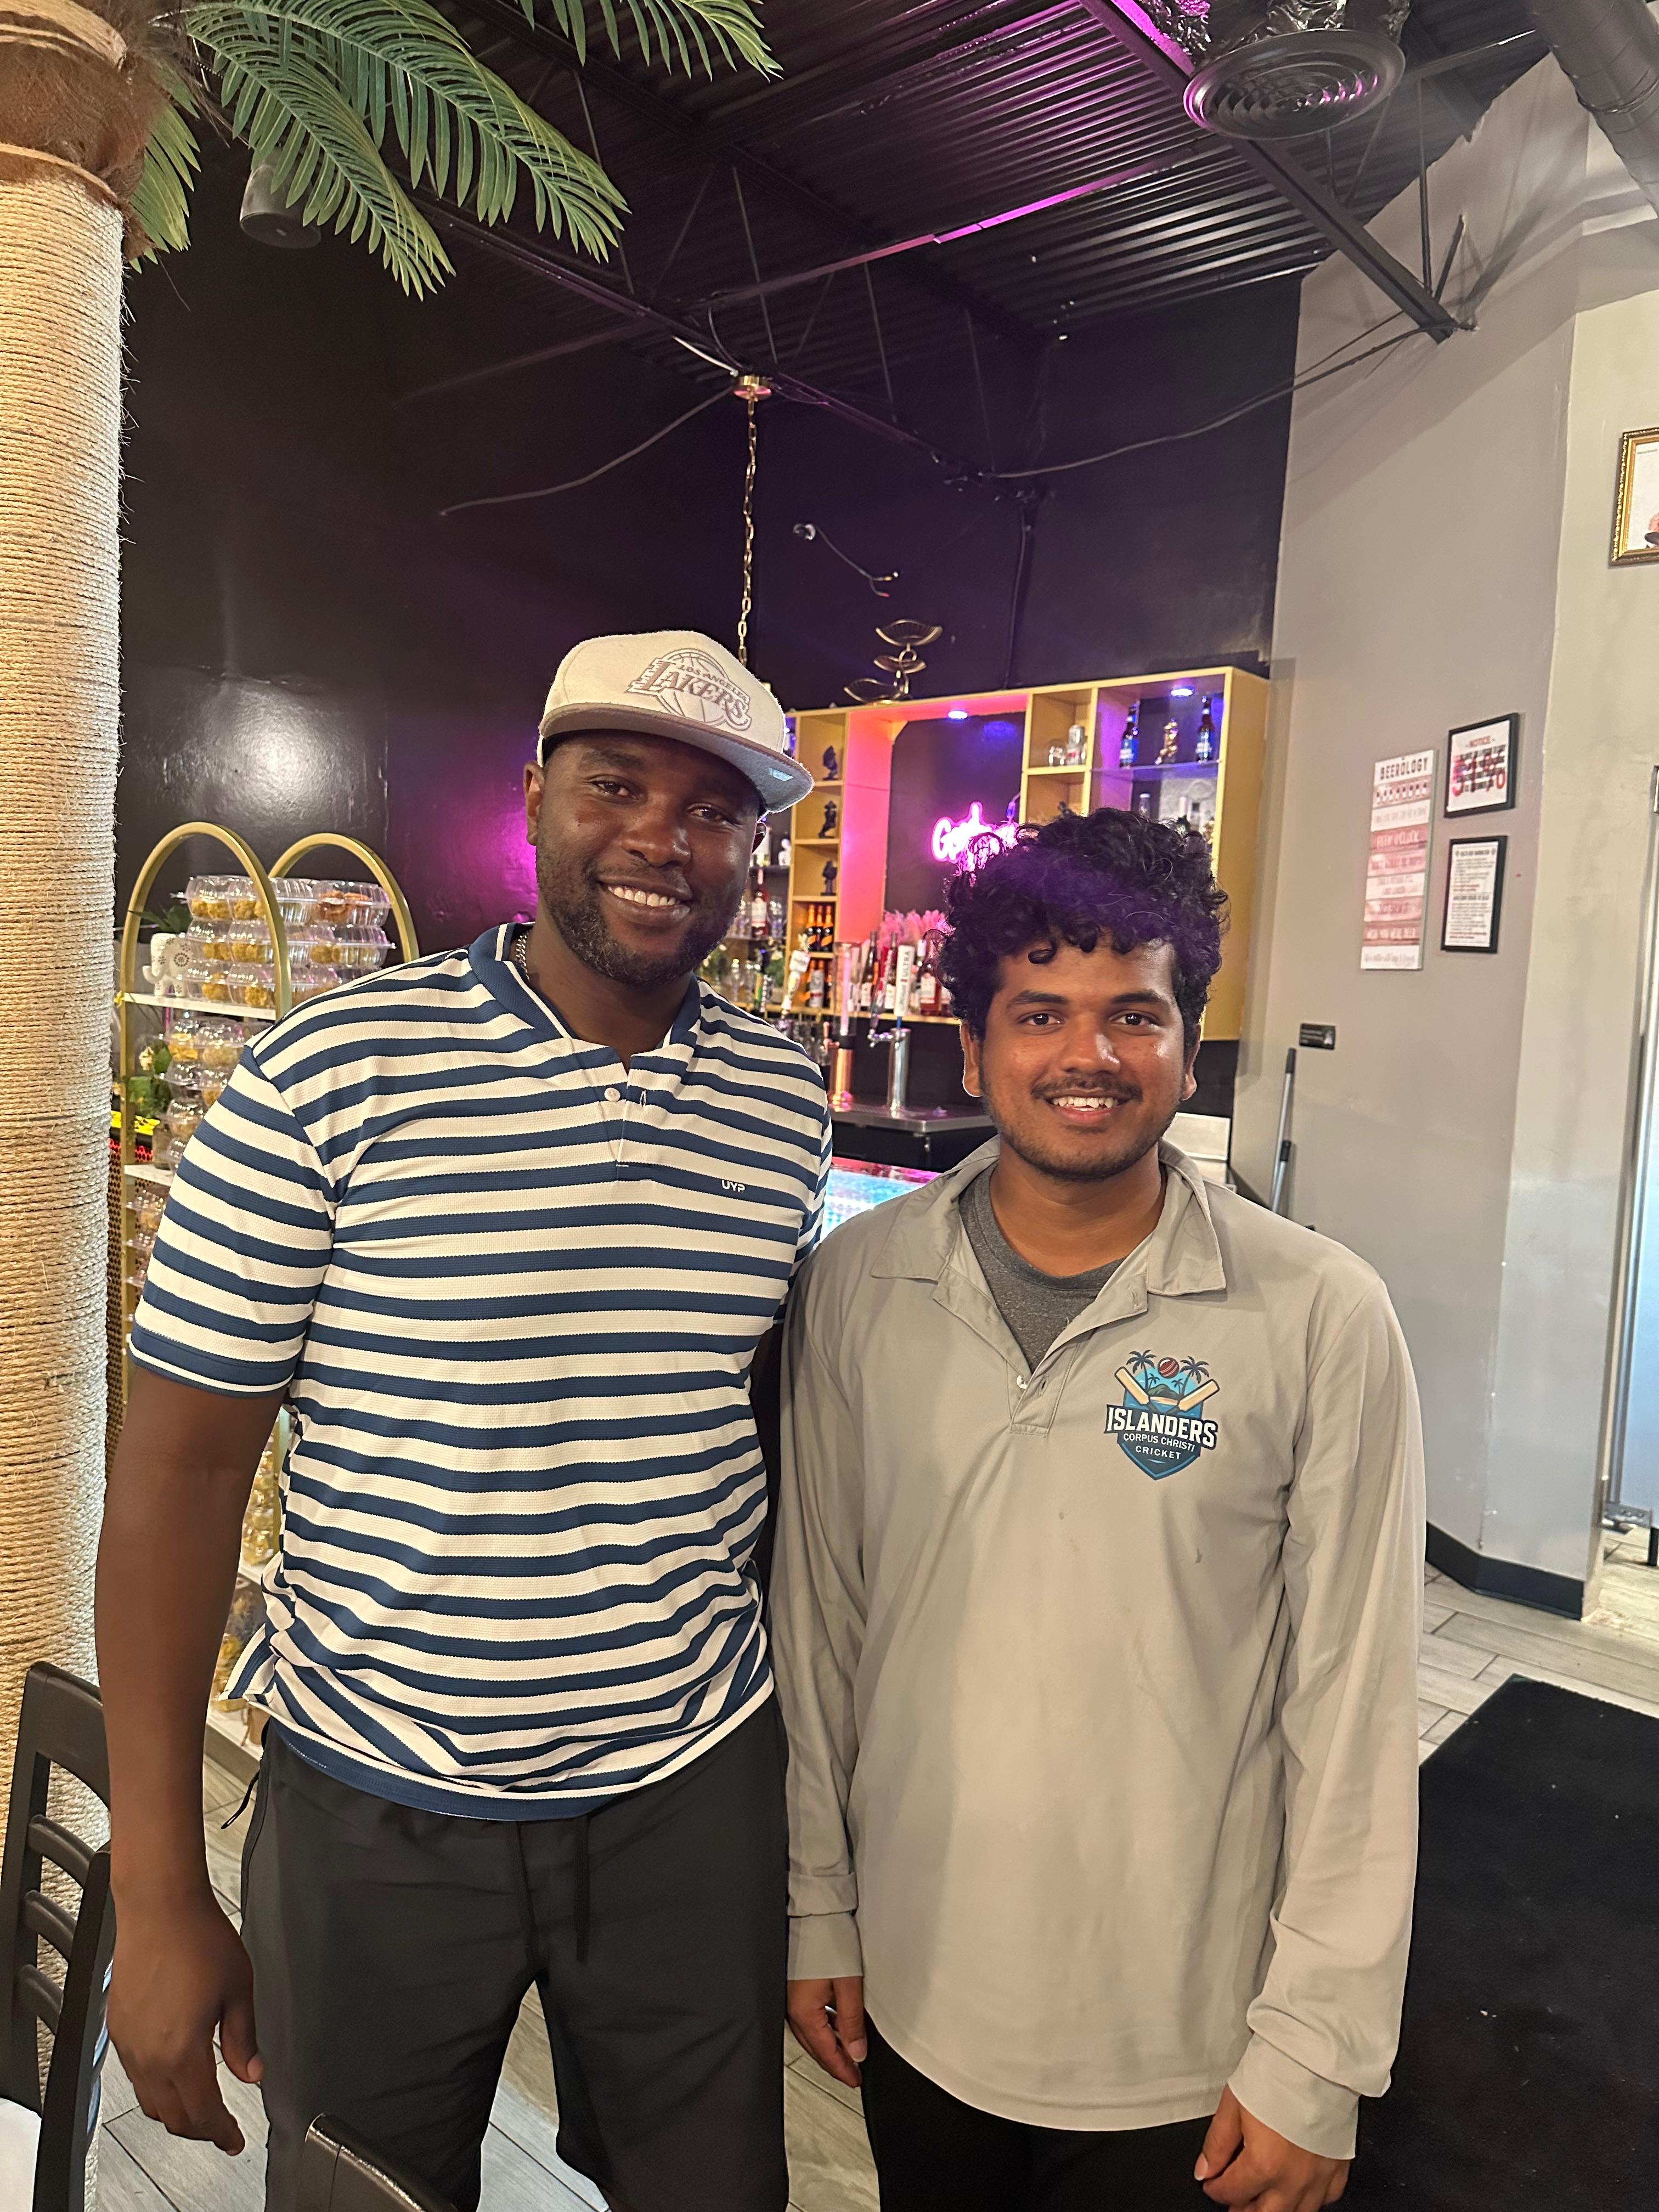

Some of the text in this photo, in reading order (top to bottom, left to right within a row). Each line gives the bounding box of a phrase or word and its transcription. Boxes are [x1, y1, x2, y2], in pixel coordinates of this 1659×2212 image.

[635, 660, 749, 726] LAKERS
[677, 664, 748, 702] LOS ANGELES
[1380, 757, 1429, 780] BEEROLOGY
[721, 1180, 746, 1192] UYP
[1106, 1407, 1217, 1448] ISLANDERS
[1123, 1433, 1195, 1452] CORPUS CHRISTI
[1135, 1445, 1181, 1460] CRICKET
